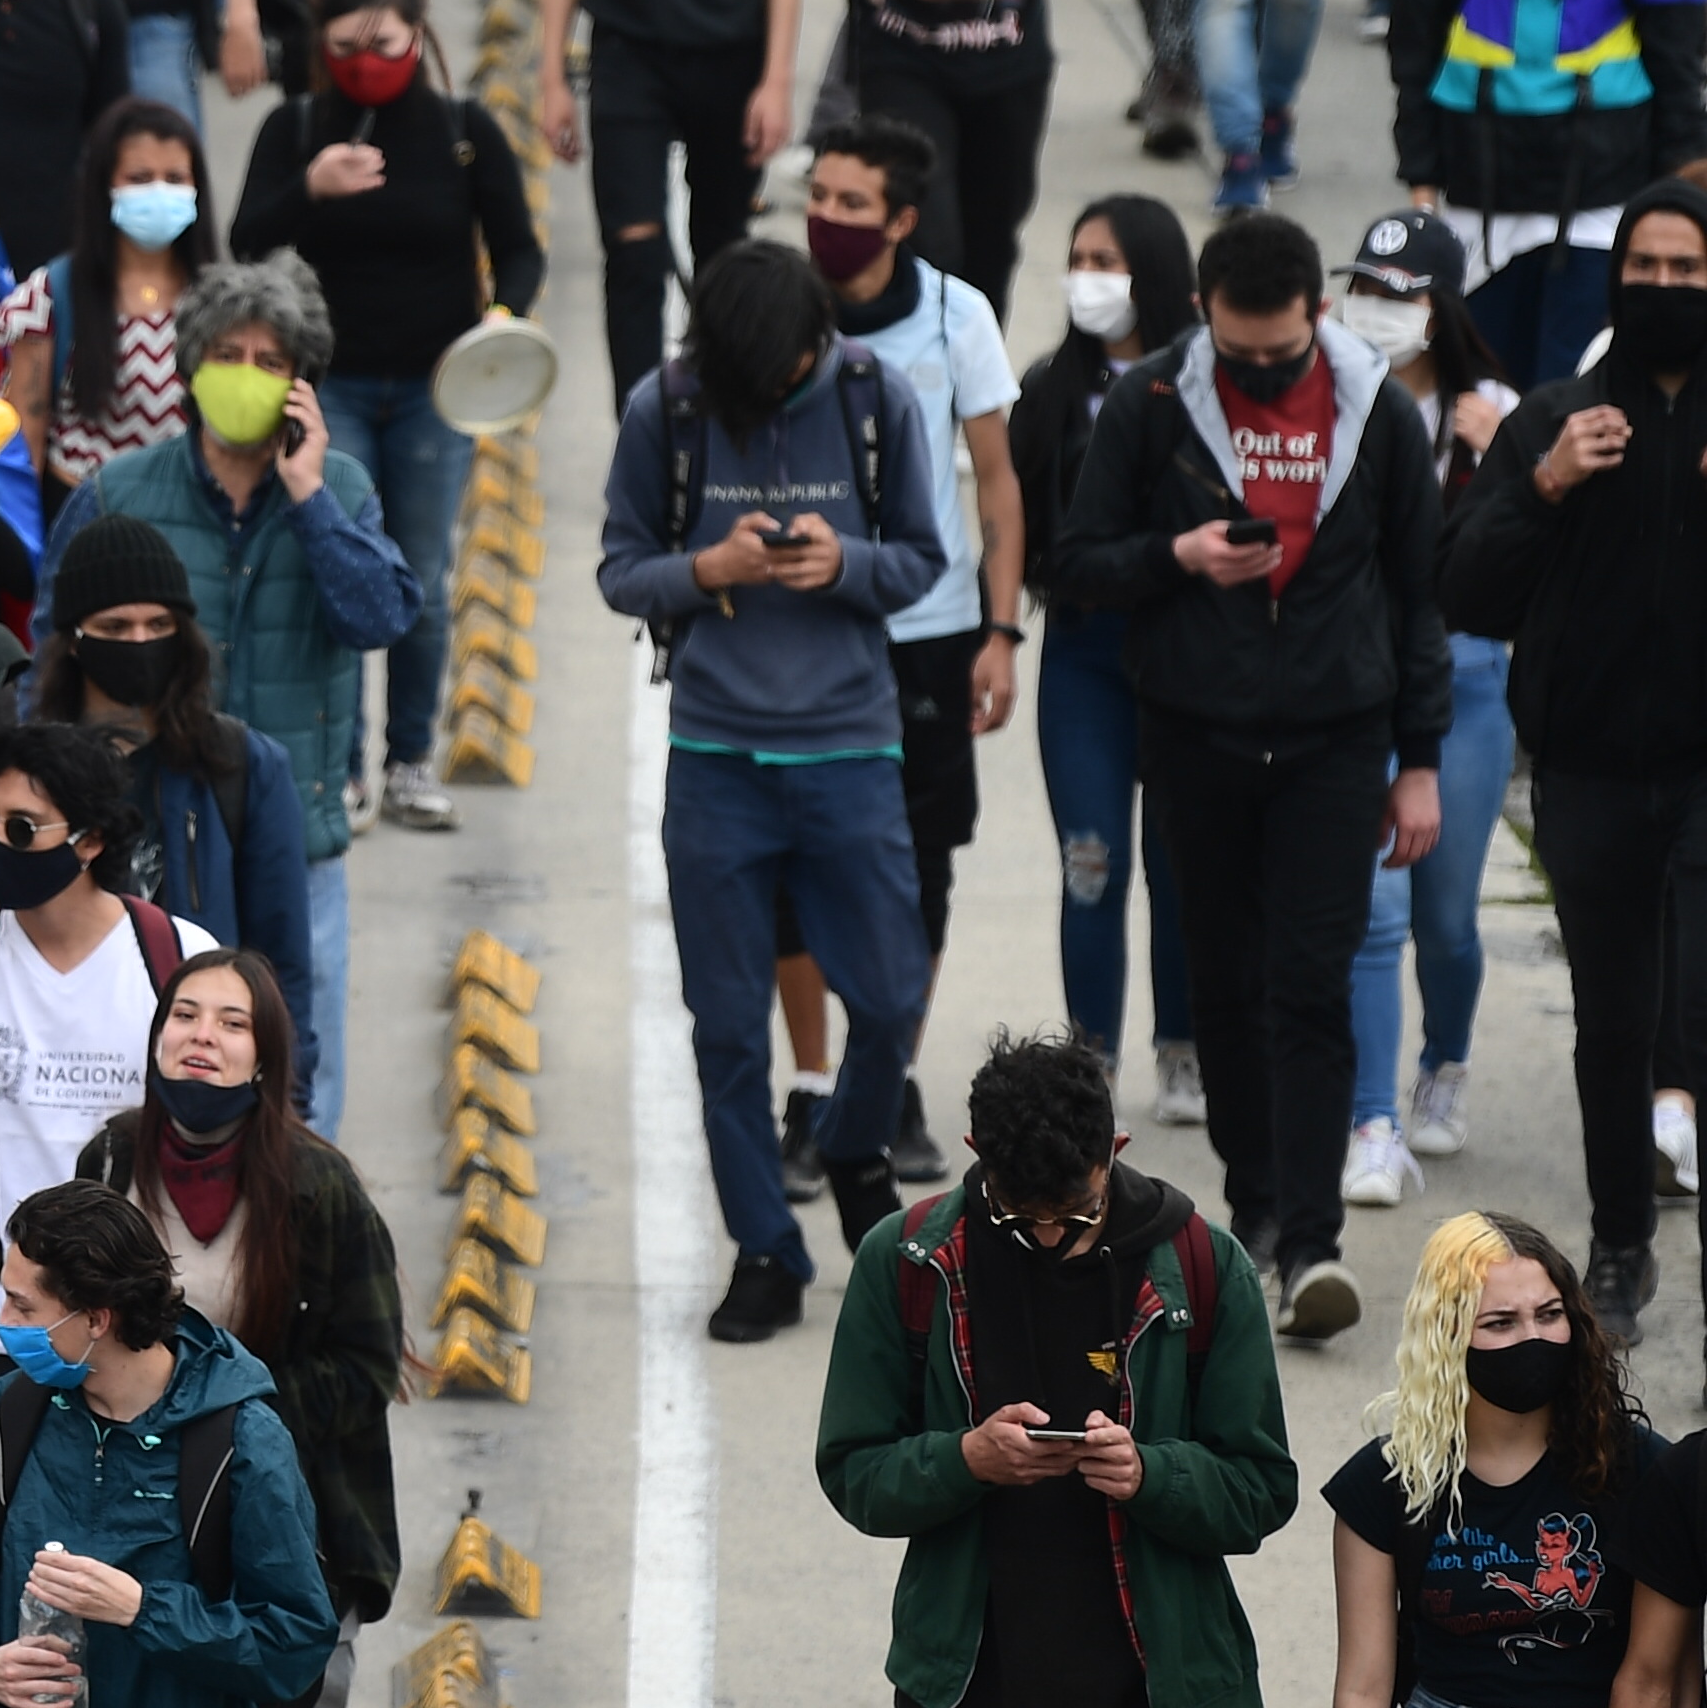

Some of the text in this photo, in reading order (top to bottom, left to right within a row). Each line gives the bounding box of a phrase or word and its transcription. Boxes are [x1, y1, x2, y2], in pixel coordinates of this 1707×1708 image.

[1233, 427, 1318, 459] Out of
[1266, 456, 1327, 483] worl
[37, 1065, 141, 1085] NACIONA
[1463, 1527, 1494, 1546] like
